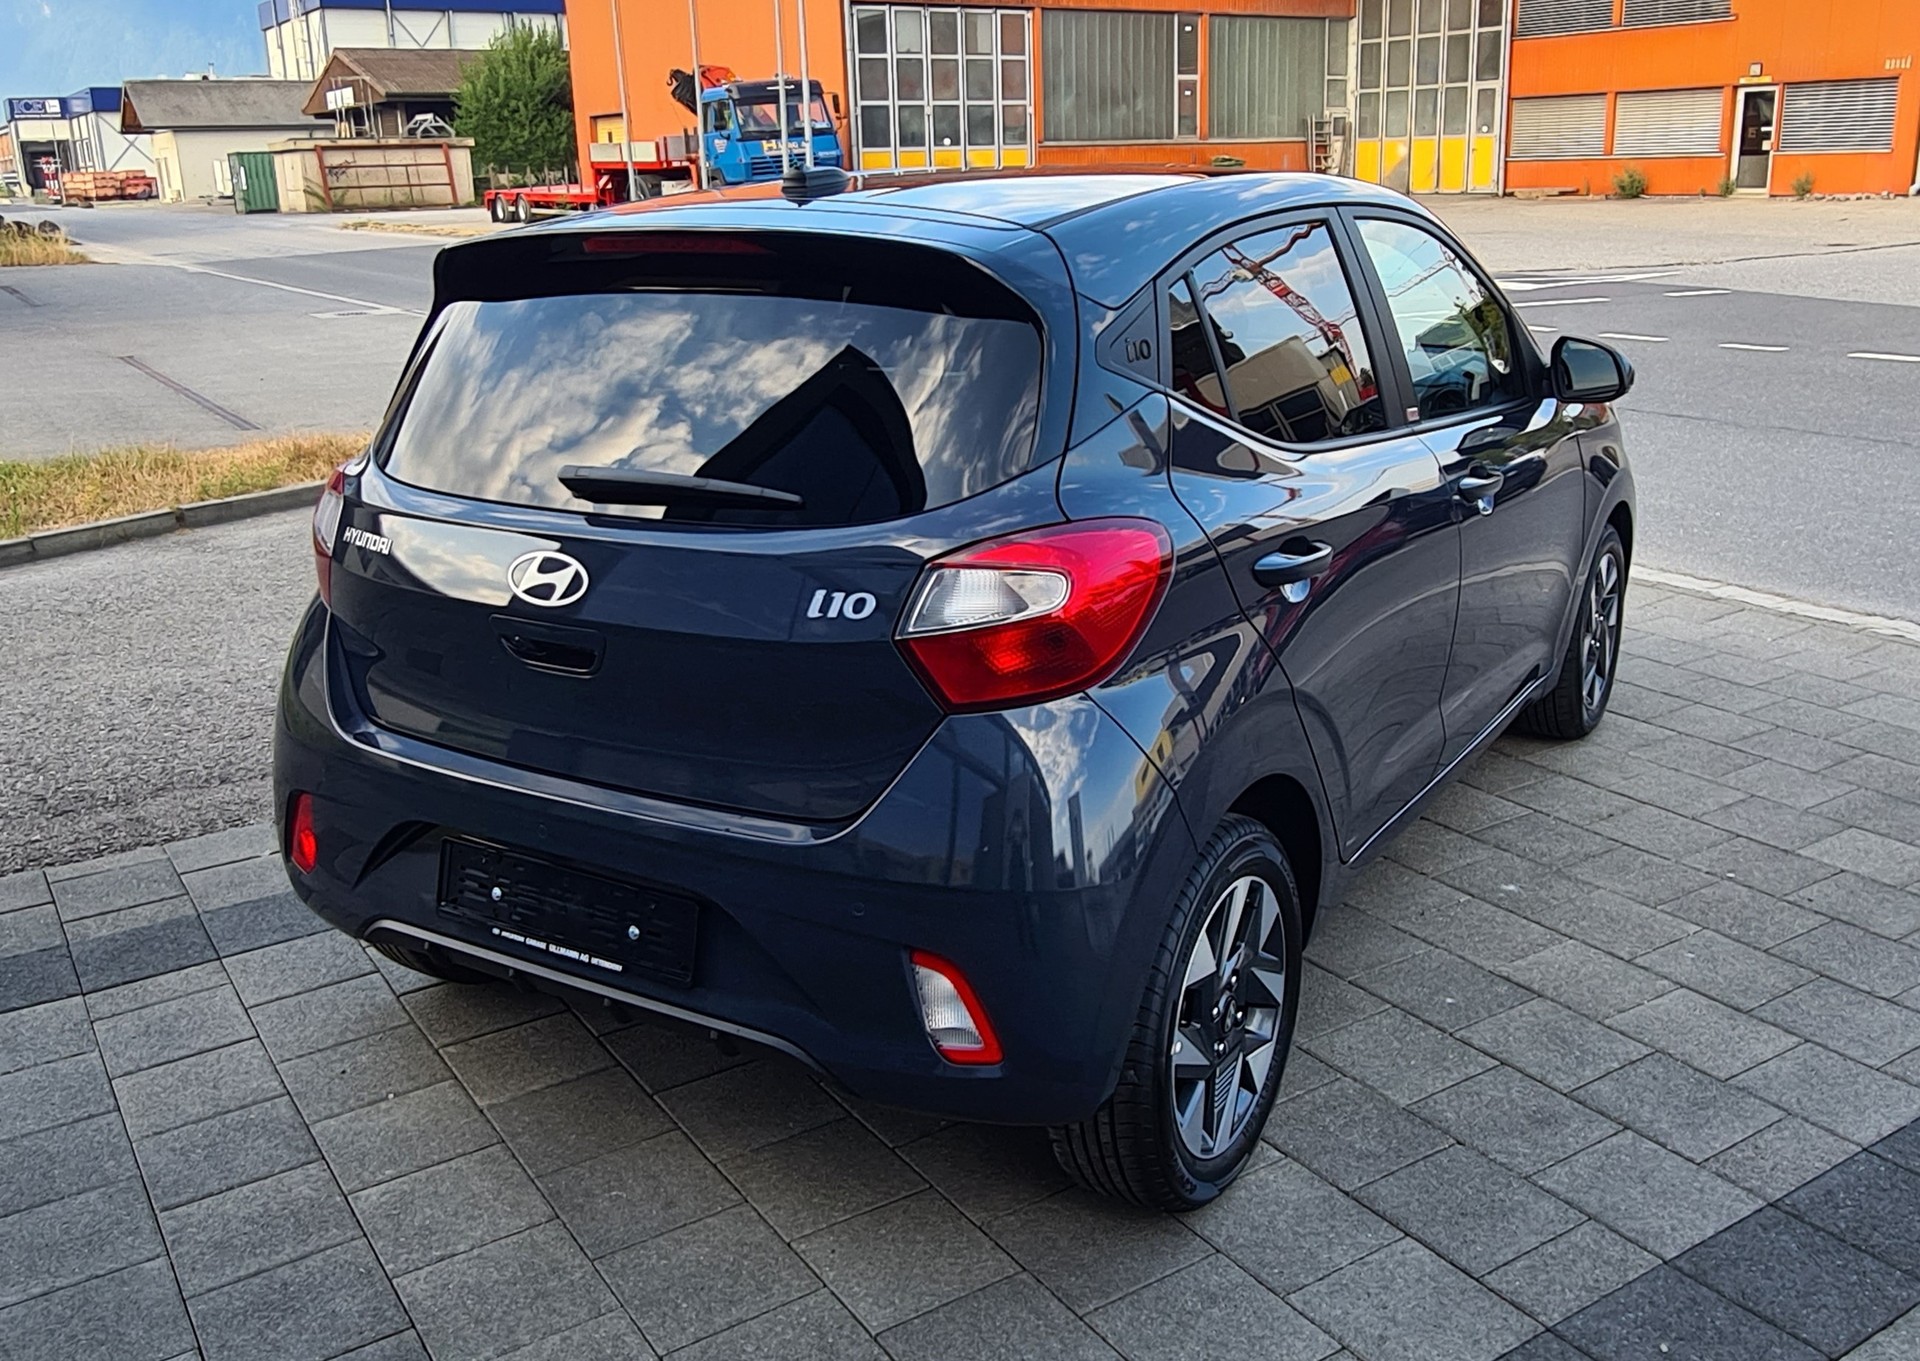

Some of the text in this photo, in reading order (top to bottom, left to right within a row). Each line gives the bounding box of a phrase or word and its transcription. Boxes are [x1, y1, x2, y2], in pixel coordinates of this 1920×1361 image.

[1124, 337, 1152, 364] i10
[342, 526, 392, 556] HYUNDAI
[806, 588, 877, 620] i10
